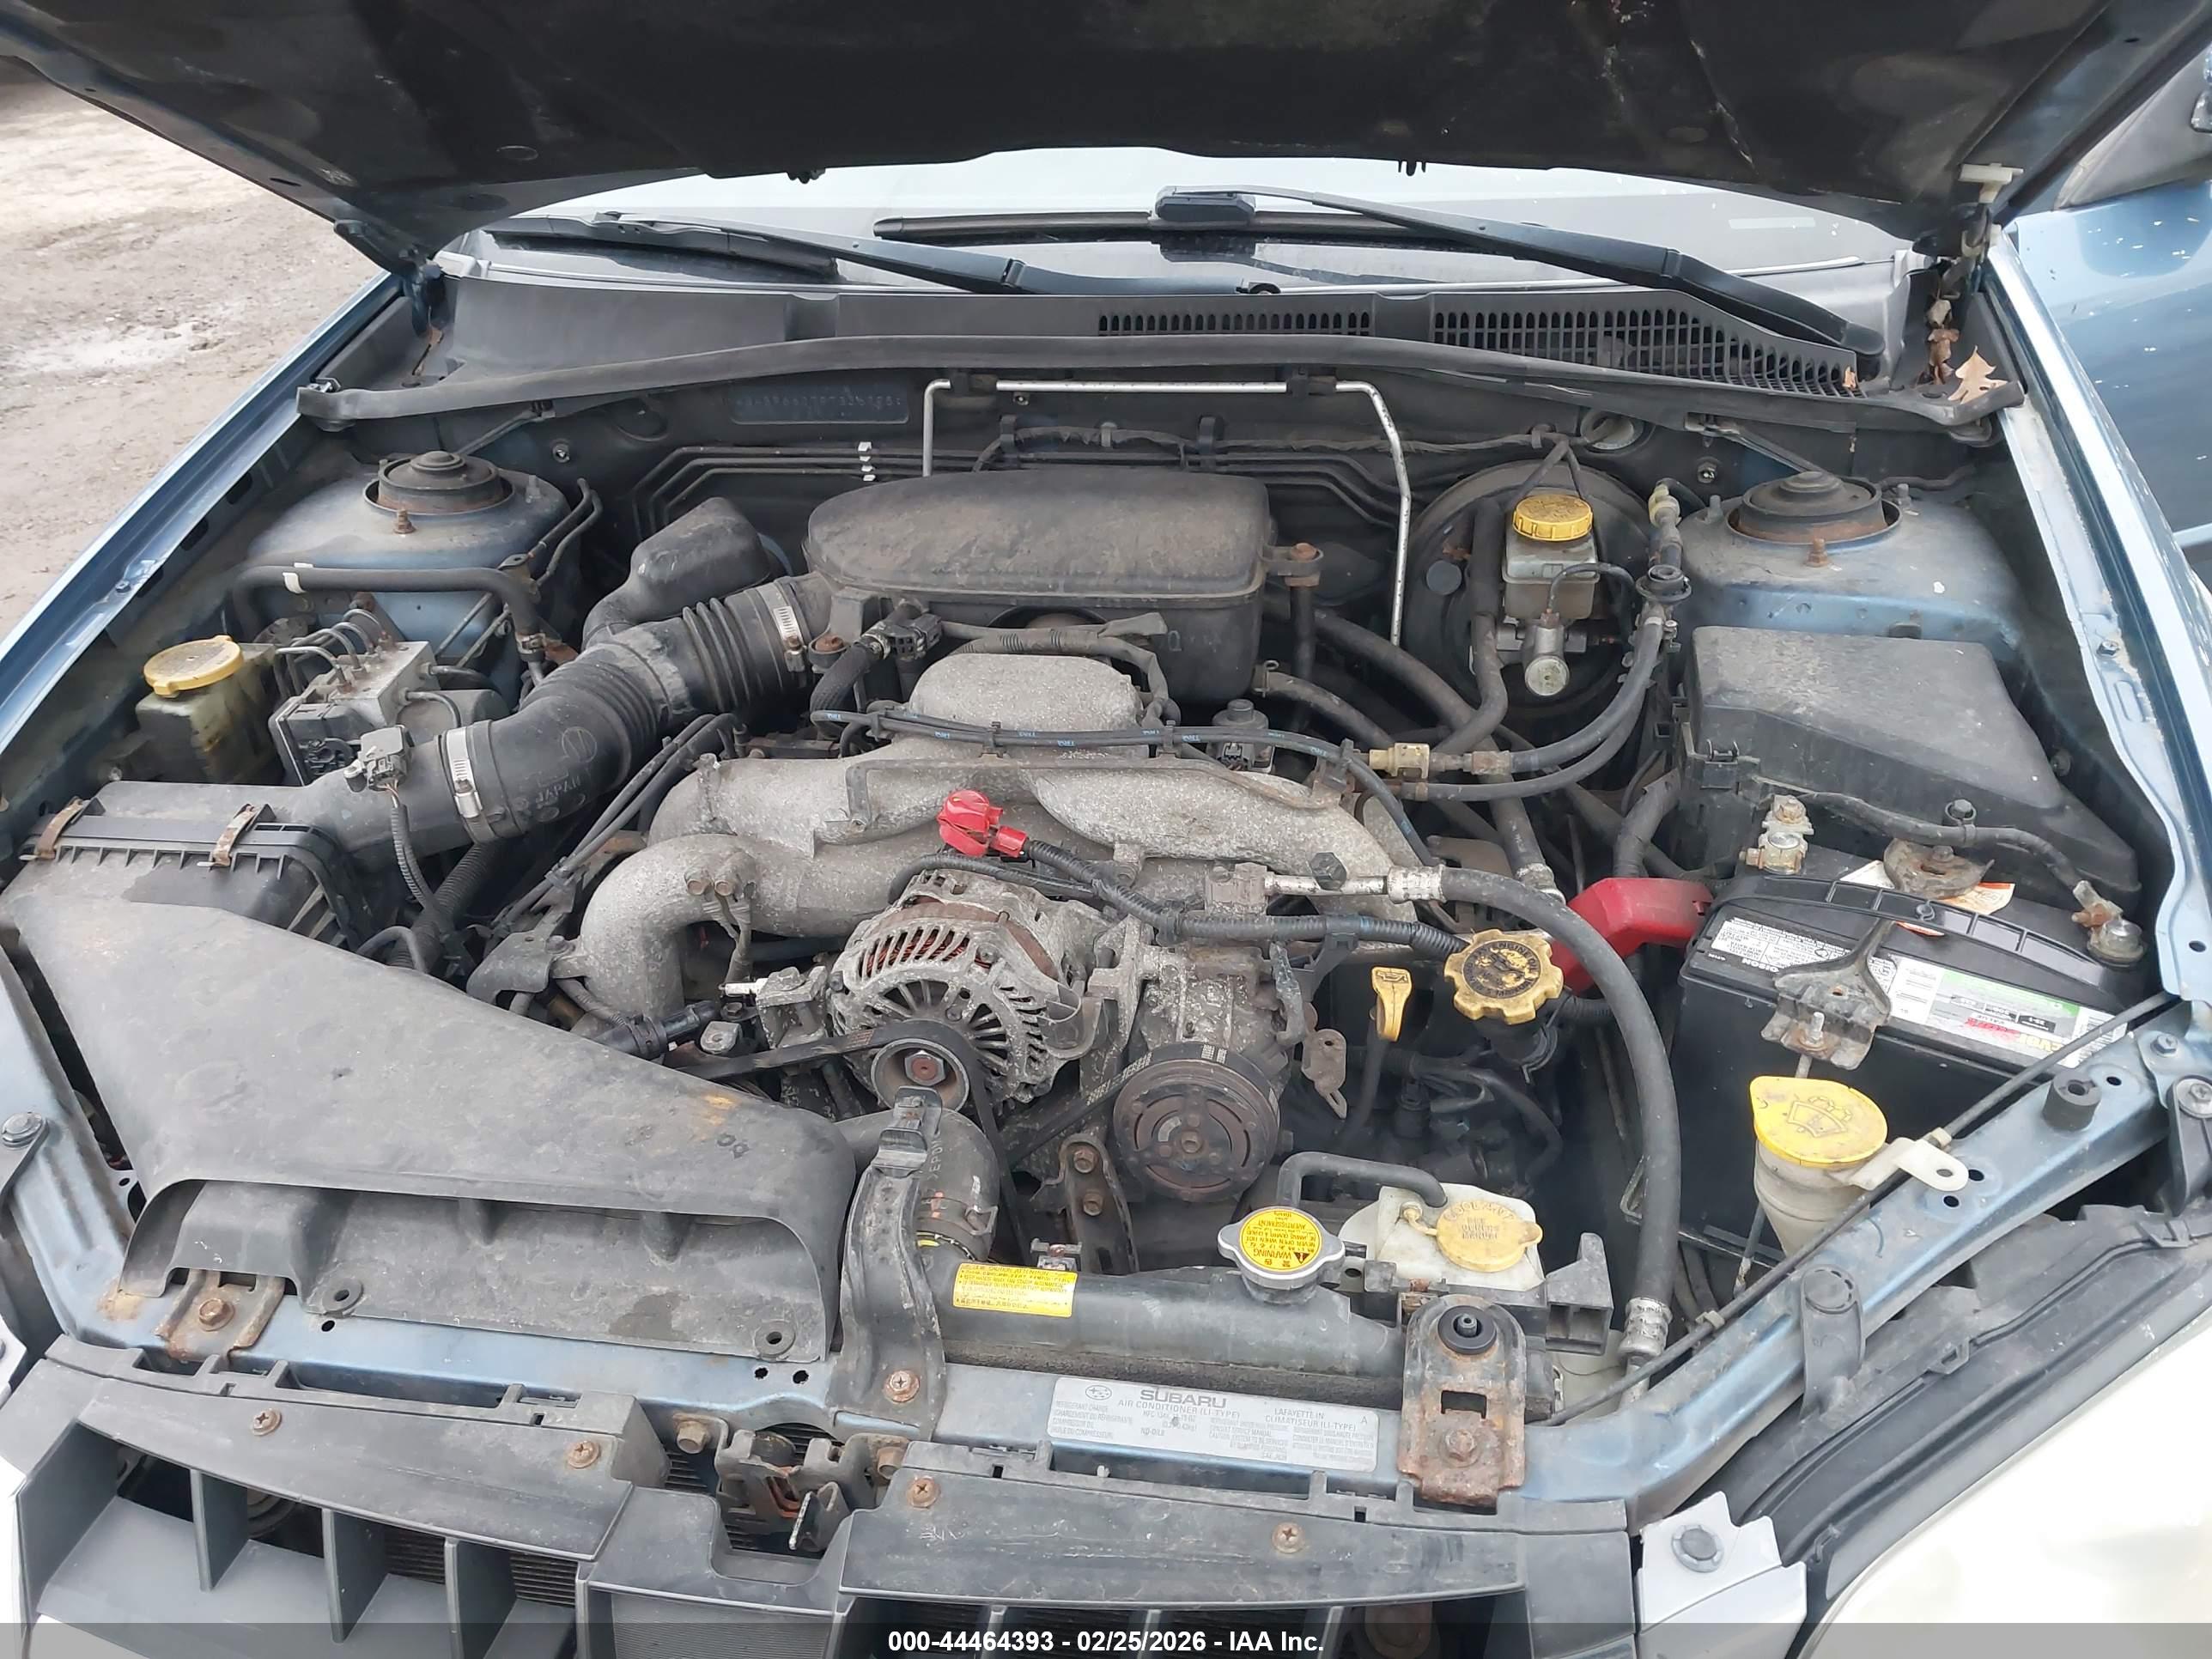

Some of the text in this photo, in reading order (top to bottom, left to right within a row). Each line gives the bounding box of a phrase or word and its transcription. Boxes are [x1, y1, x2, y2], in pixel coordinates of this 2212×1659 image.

[1253, 1249, 1291, 1260] WARNING
[1140, 1389, 1227, 1408] SUBARU
[1135, 1401, 1197, 1413] CONDITIONER
[1265, 1414, 1318, 1427] CLIMATISEUR
